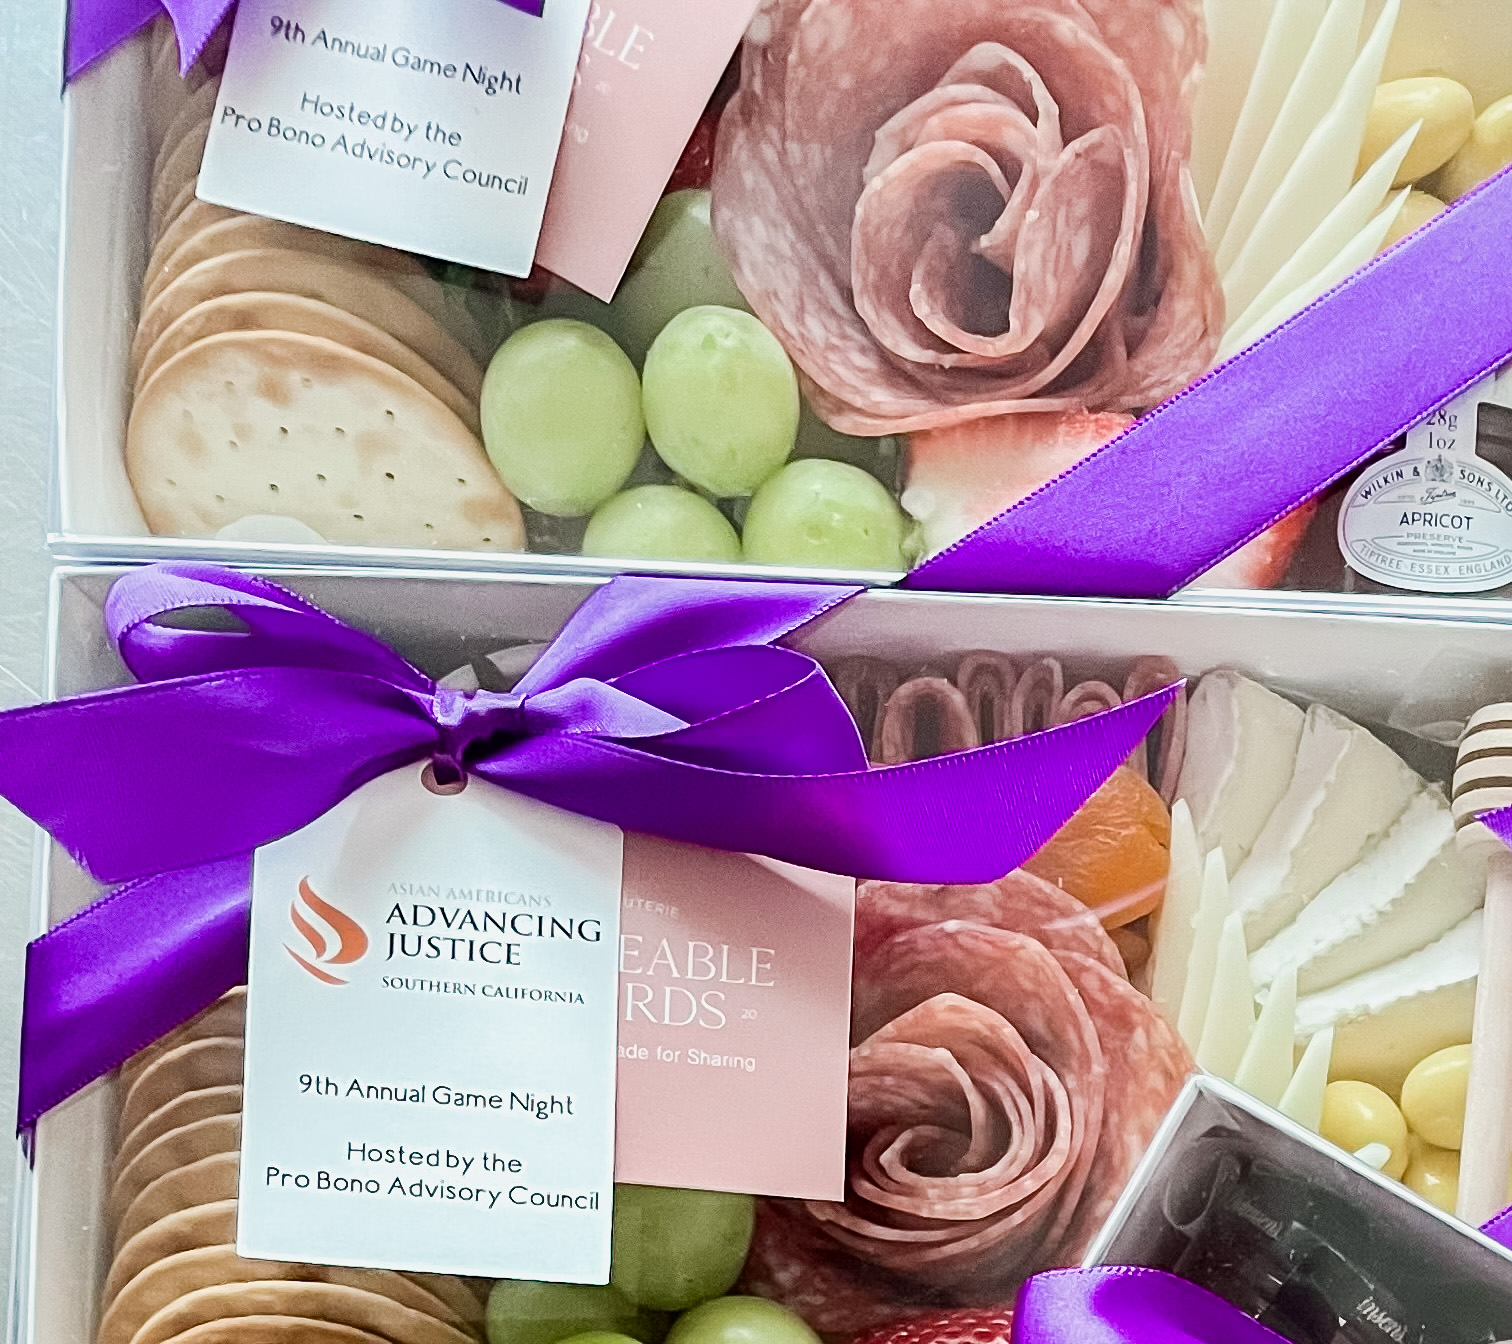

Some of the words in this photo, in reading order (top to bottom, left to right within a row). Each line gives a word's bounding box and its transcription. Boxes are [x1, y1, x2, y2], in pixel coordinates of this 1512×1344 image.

[270, 16, 305, 44] 9th
[312, 28, 386, 62] Annual
[392, 48, 457, 79] Game
[462, 63, 521, 95] Night
[301, 92, 386, 129] Hosted
[393, 112, 418, 141] by
[426, 121, 462, 146] the
[221, 105, 261, 133] Pro
[268, 117, 325, 148] Bono
[331, 134, 436, 179] Advisory
[443, 160, 528, 195] Council
[1426, 408, 1458, 430] 28g
[1429, 432, 1456, 449] 1oz
[1360, 469, 1404, 501] WILKIN
[1413, 466, 1420, 476] &
[1459, 470, 1493, 492] SONS
[1400, 512, 1474, 531] APRICOT
[1406, 532, 1463, 543] PRESERVE
[1359, 544, 1402, 569] TIPTREE
[1411, 563, 1449, 575] ESSEX
[1459, 555, 1512, 574] ENGLAND
[388, 882, 440, 898] ASIAN
[446, 888, 552, 907] AMERICANS
[386, 903, 601, 942] ADVANCING
[385, 933, 521, 966] JUSTICE
[382, 976, 475, 996] SOUTHERN
[482, 985, 585, 1005] CALIFORNIA
[656, 1046, 680, 1063] for
[687, 1049, 756, 1072] Sharing
[299, 1074, 338, 1097] 9th
[346, 1078, 425, 1102] Annual
[432, 1086, 502, 1108] Game
[510, 1092, 574, 1120] Night
[347, 1142, 439, 1168] Hosted
[446, 1150, 474, 1175] by
[483, 1152, 522, 1173] the
[267, 1167, 310, 1188] Pro
[318, 1171, 380, 1193] Bono
[388, 1177, 501, 1209] Advisory
[509, 1186, 599, 1210] Council
